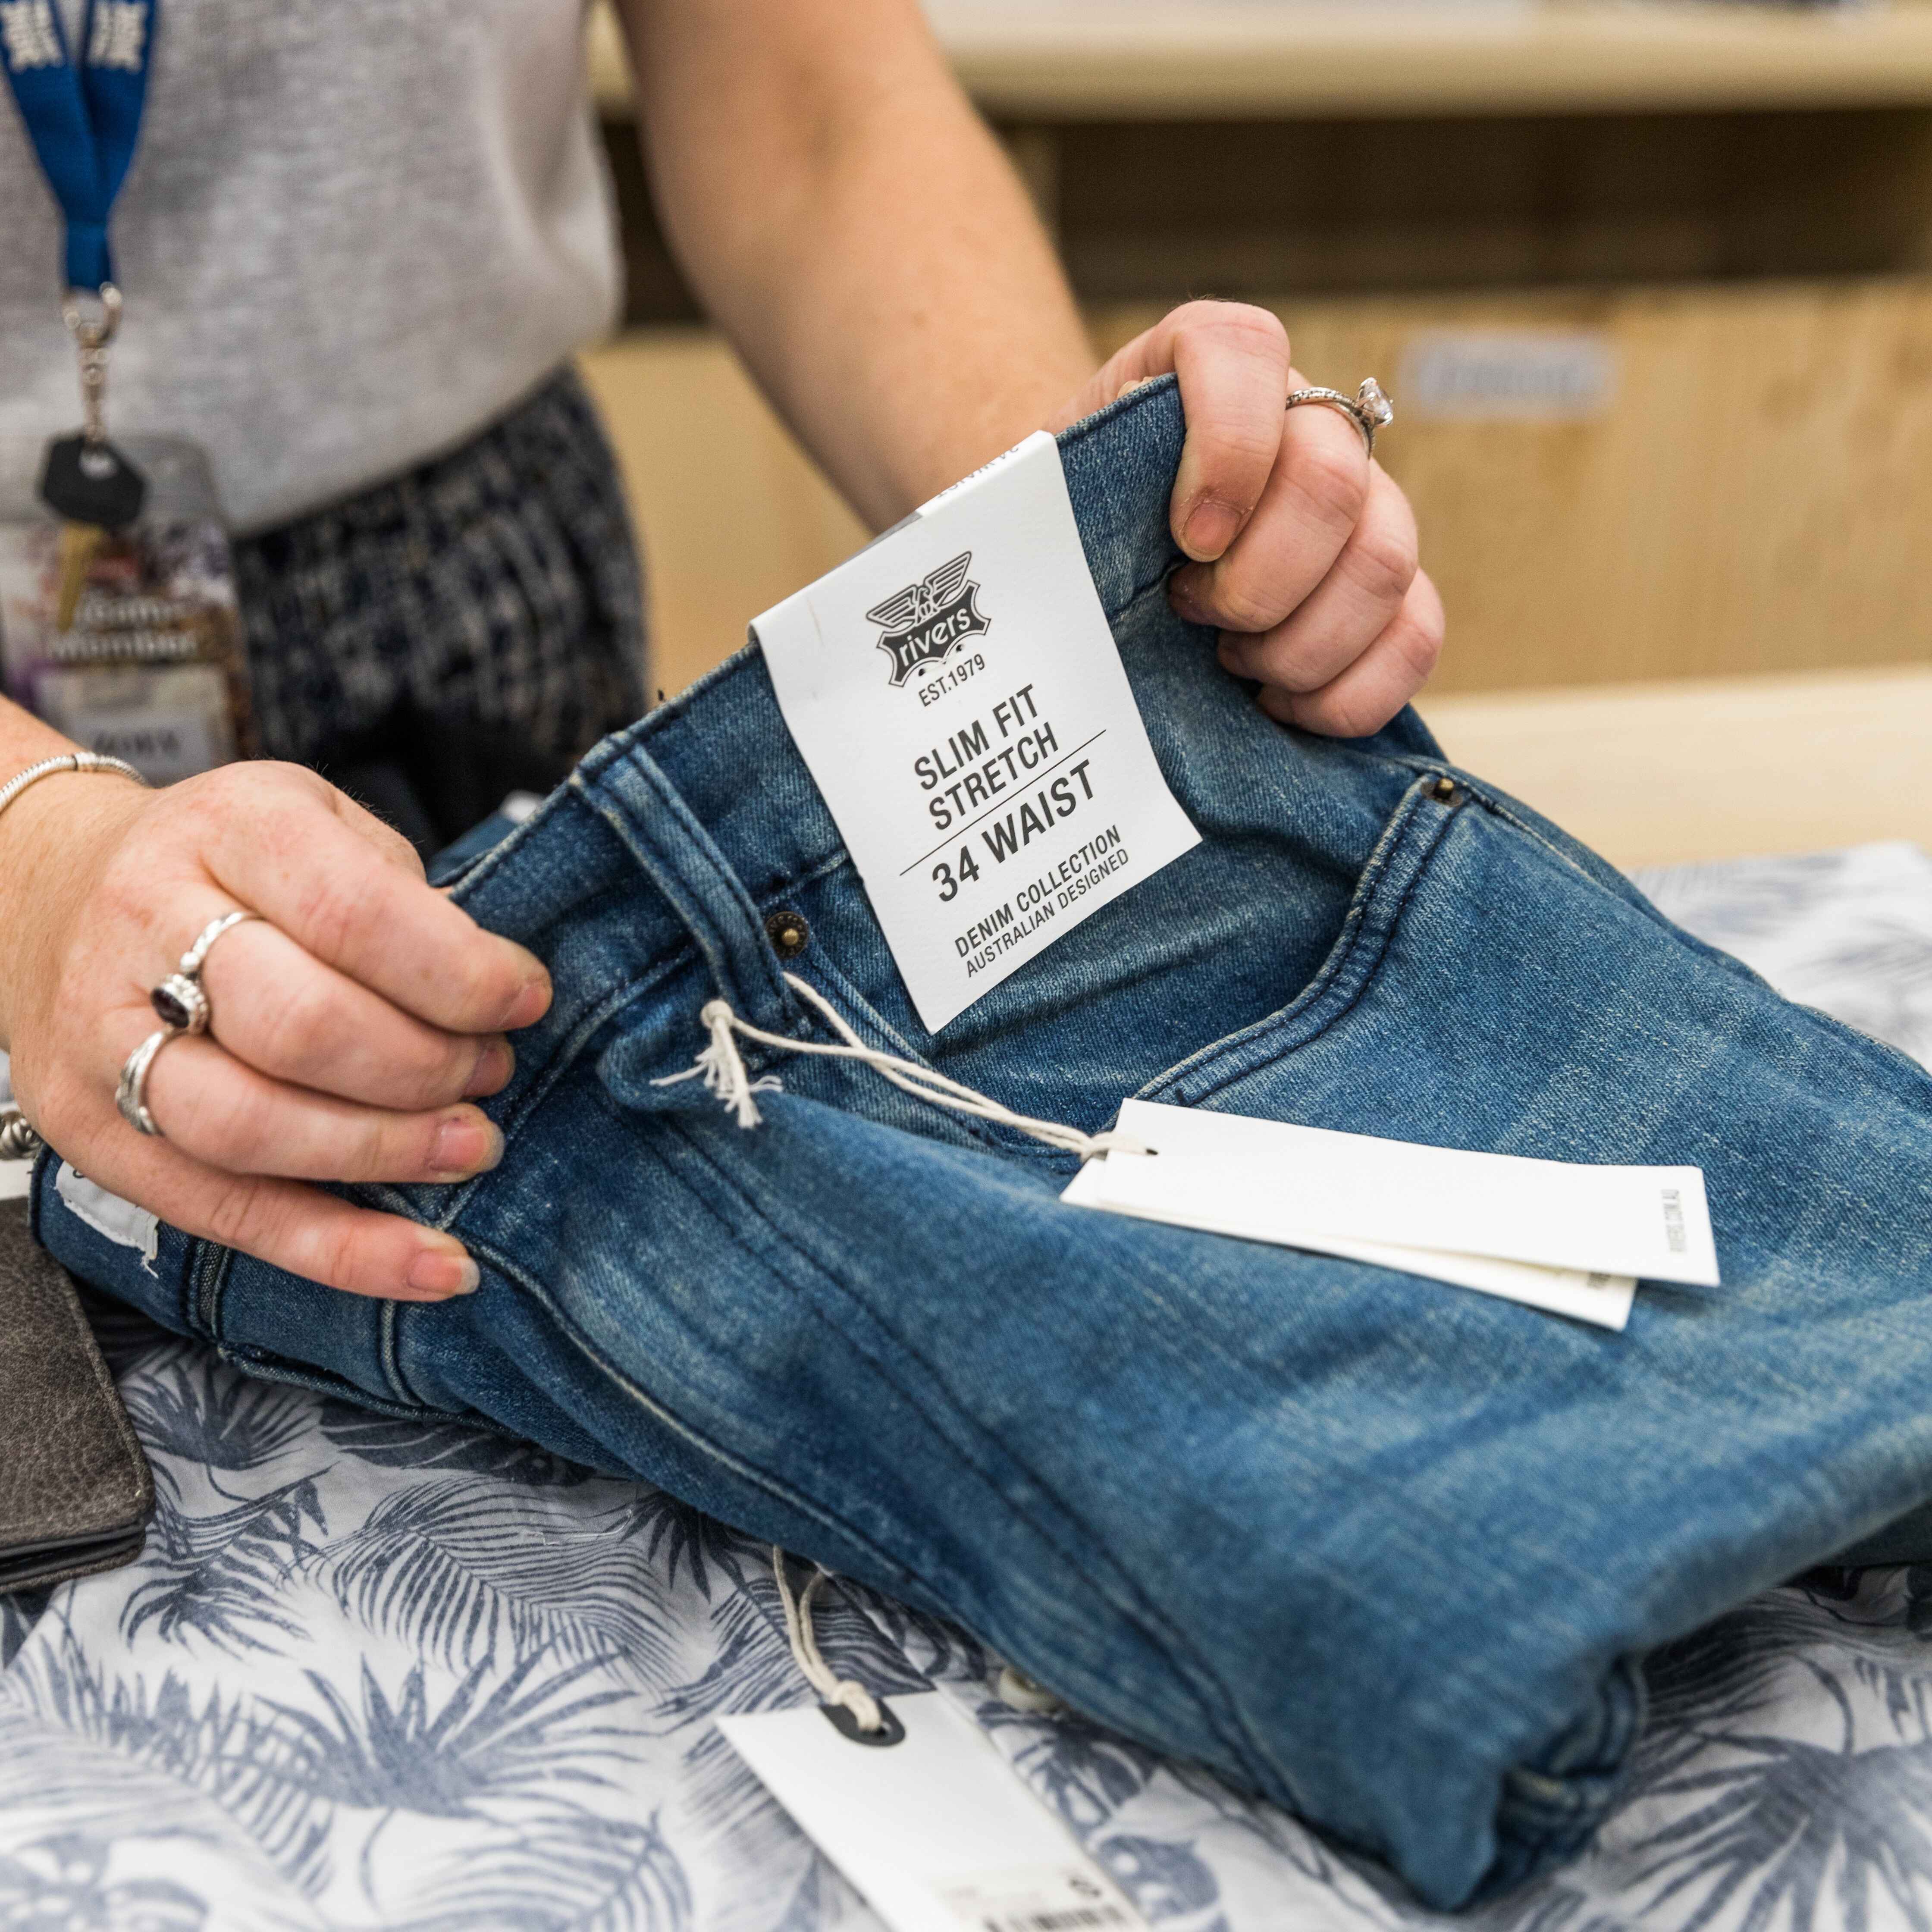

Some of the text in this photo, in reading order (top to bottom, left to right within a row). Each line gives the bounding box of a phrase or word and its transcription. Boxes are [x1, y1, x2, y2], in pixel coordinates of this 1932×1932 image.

[899, 608, 971, 667] rivers
[918, 653, 986, 708] EST.1979
[914, 684, 1038, 790] SLIM FIT
[929, 721, 1059, 830] STRETCH
[932, 759, 1094, 902] 34 WAIST
[954, 825, 1121, 958] DENIM COLLECTION
[966, 849, 1129, 978] AUSTRALIAN DESIGNED
